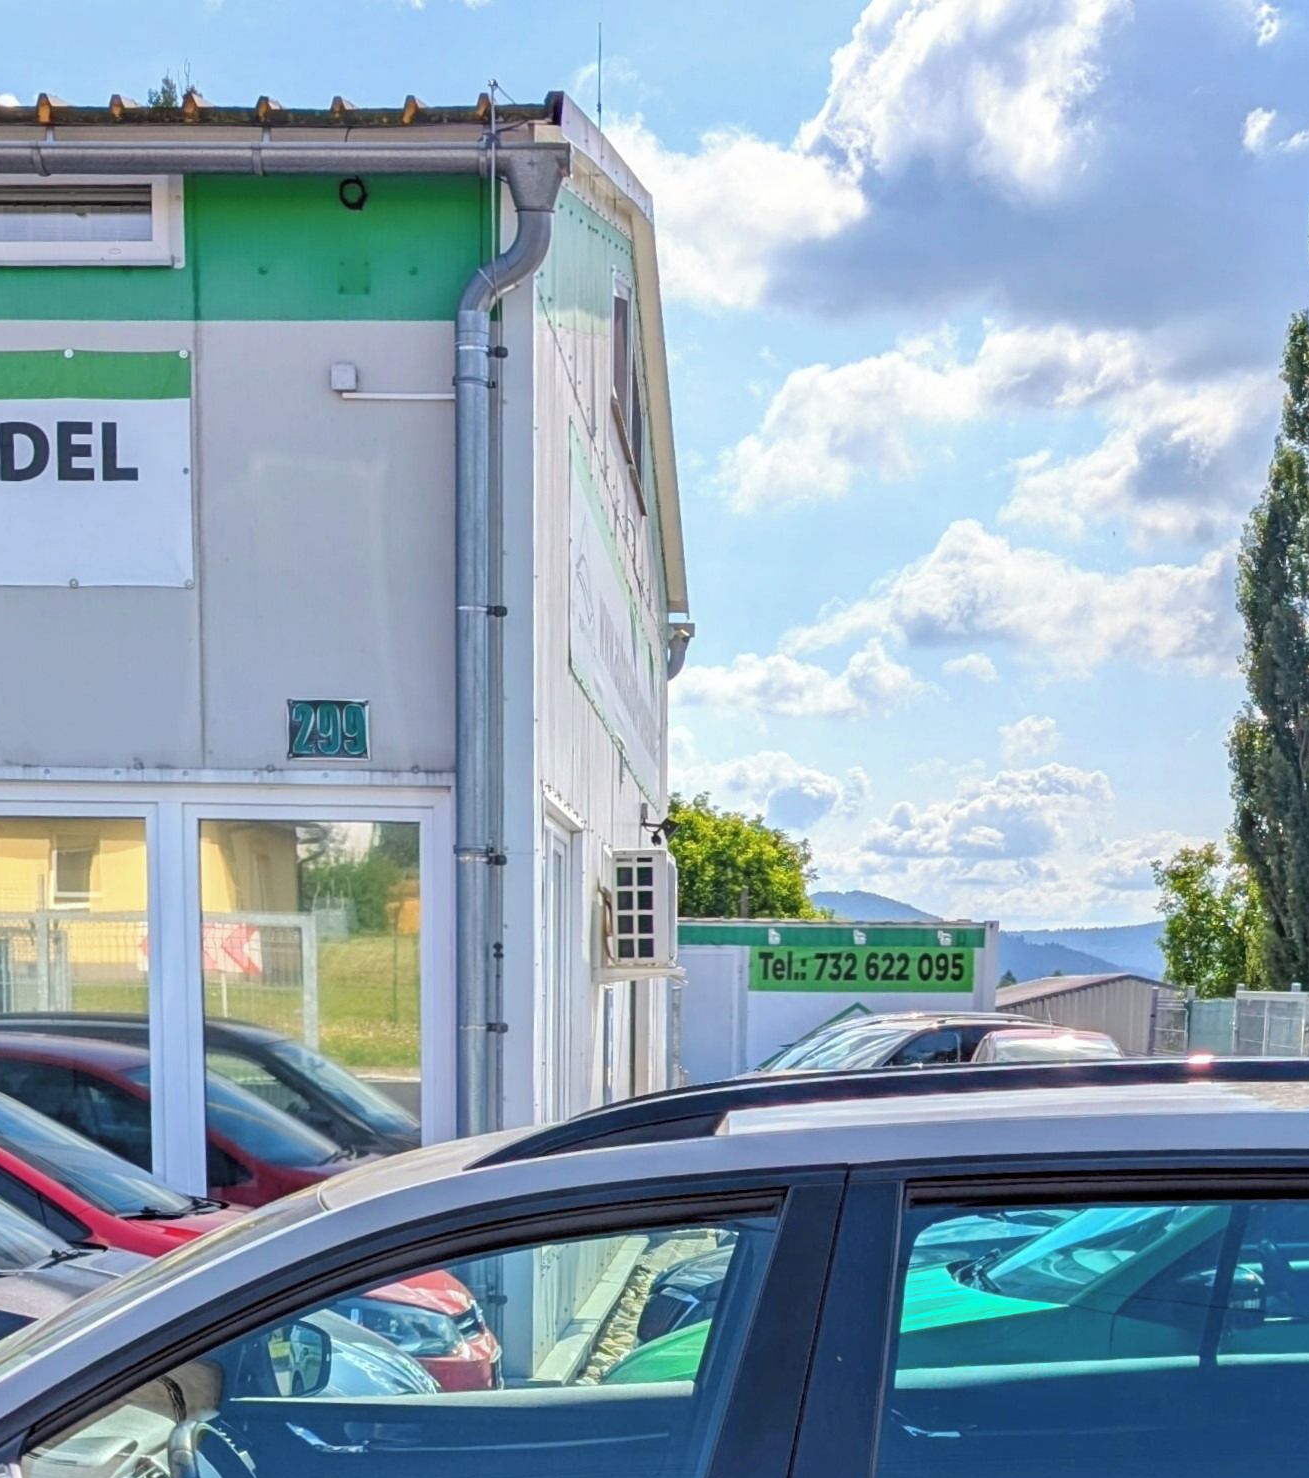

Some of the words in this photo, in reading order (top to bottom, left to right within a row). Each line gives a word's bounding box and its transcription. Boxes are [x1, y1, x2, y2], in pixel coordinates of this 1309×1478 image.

[291, 702, 366, 755] 299
[758, 951, 808, 981] Tel.:
[814, 952, 858, 982] 732
[864, 952, 910, 982] 622
[916, 953, 965, 982] 095
